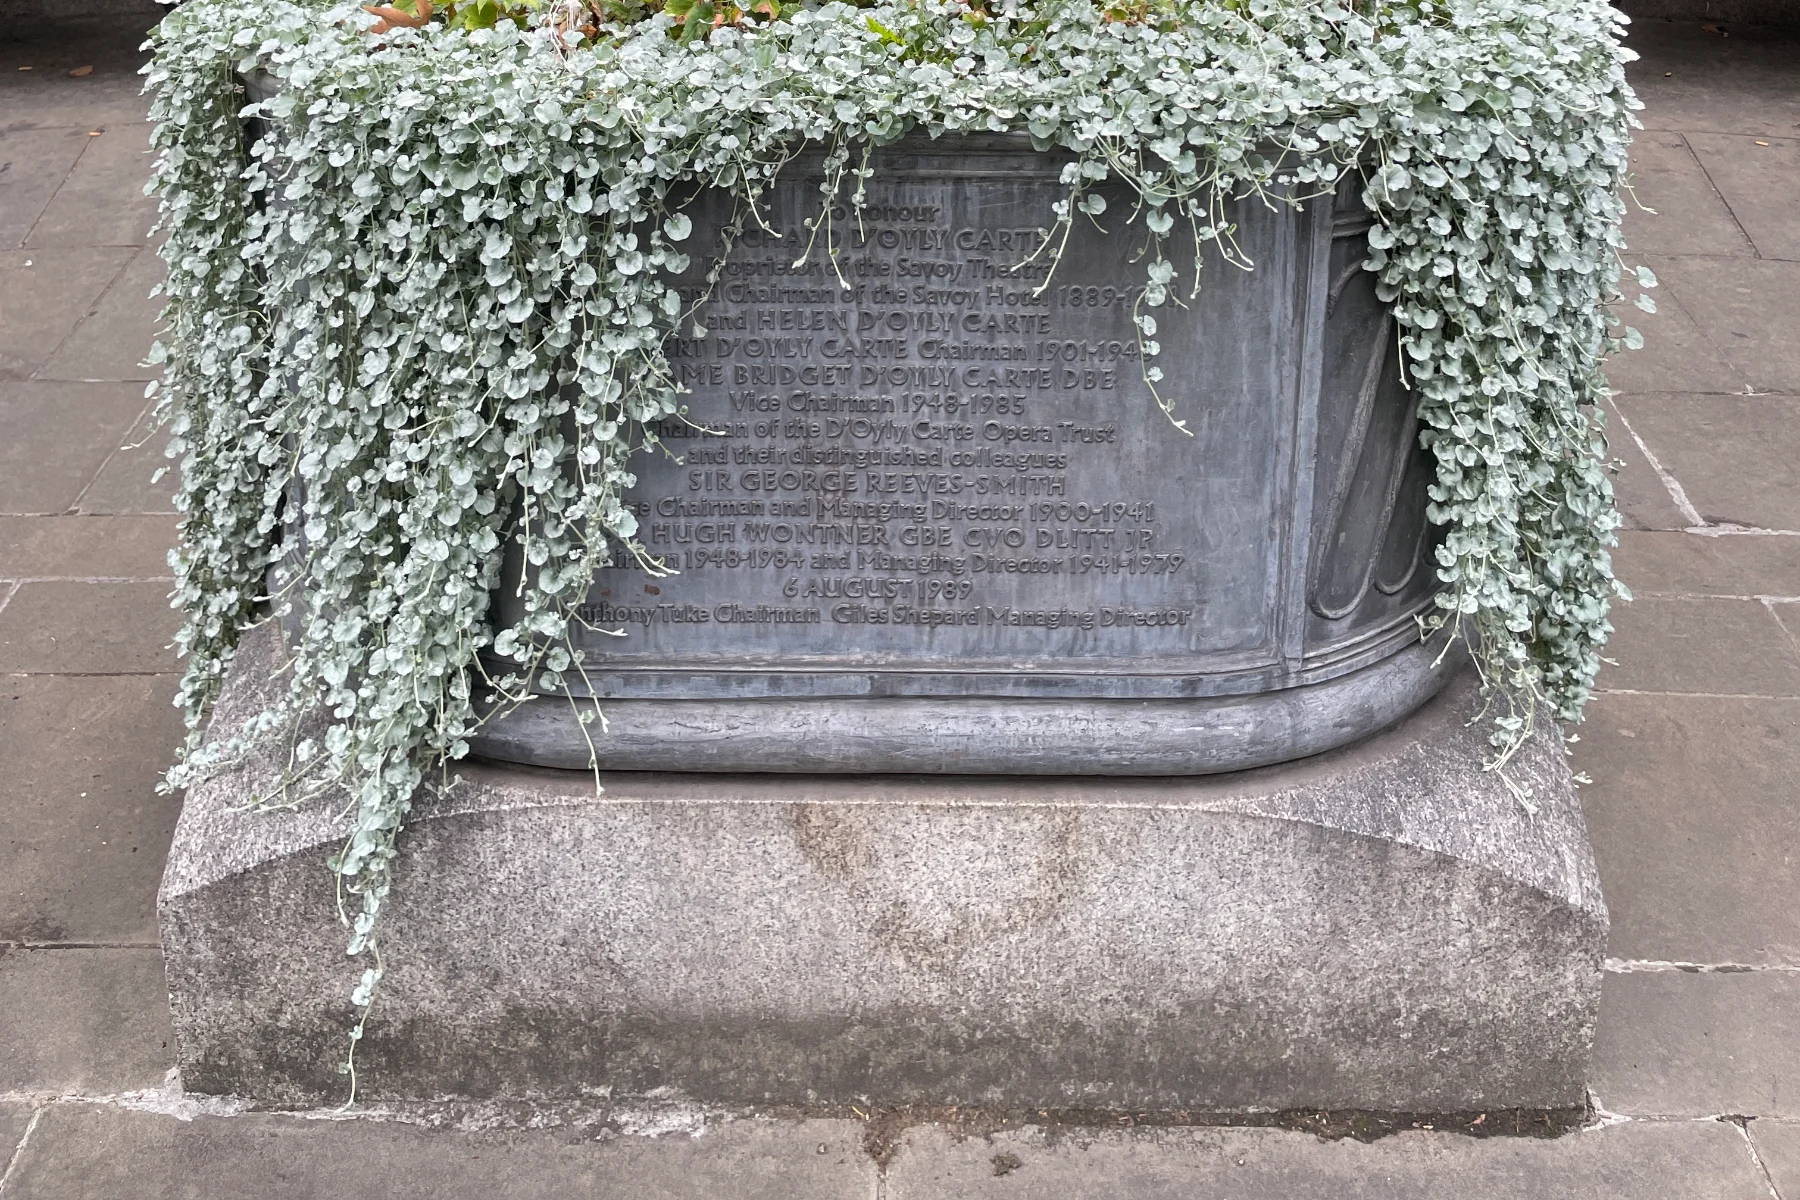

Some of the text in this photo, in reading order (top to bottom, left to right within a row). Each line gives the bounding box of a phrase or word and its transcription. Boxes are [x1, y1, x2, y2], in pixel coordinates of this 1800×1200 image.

[851, 226, 949, 251] D'OYLY
[956, 227, 1047, 252] CARTE
[824, 254, 851, 277] of
[854, 254, 891, 277] the
[897, 256, 963, 283] Savoy
[967, 256, 1054, 280] Theatre
[724, 281, 835, 304] Chairman
[840, 282, 867, 304] of
[871, 283, 908, 305] the
[912, 283, 981, 309] Savoy
[985, 284, 1049, 307] Hotel
[706, 308, 1051, 334] and HELEN D'OYLY CARTE
[662, 336, 1153, 363] ERT D'OYLY CARTE Chairman 1901-194
[734, 363, 852, 386] BRIDGET
[860, 364, 956, 387] D'OYLY
[961, 365, 1054, 390] CARTE
[1061, 367, 1117, 390] DBE
[728, 389, 1028, 415] Vice Chairman 1948-1985
[754, 417, 780, 438] of
[784, 417, 821, 439] the
[826, 417, 908, 444] D'Oyly
[912, 418, 975, 441] Carte
[982, 419, 1053, 445] Opera
[1056, 420, 1117, 444] Trust
[686, 444, 1068, 471] and their distinguished colleagues
[689, 469, 1067, 496] SIR GEORGE REEVES-SMITH
[656, 495, 765, 518] Chairman
[770, 496, 812, 517] and
[816, 497, 928, 523] Managing
[931, 499, 1025, 521] Director
[1029, 500, 1156, 523] 1900-1941
[652, 522, 737, 543] HUGH
[741, 522, 889, 546] WONTNER
[899, 525, 953, 547] GBE
[963, 526, 1026, 548] CVO
[1035, 527, 1116, 550] DLITT
[1124, 527, 1155, 553] JP
[684, 548, 806, 569] 1948-1984
[810, 548, 851, 570] and
[857, 549, 967, 576] Managing
[970, 551, 1064, 574] Director
[1068, 552, 1185, 575] 1941-1979
[782, 576, 974, 600] 6 AUGUST 1989
[657, 602, 710, 623] Tuke
[713, 602, 822, 624] Chairman
[830, 603, 889, 625] Giles
[892, 603, 981, 629] Shepard
[986, 605, 1095, 630] Managing
[1099, 606, 1193, 629] Director
